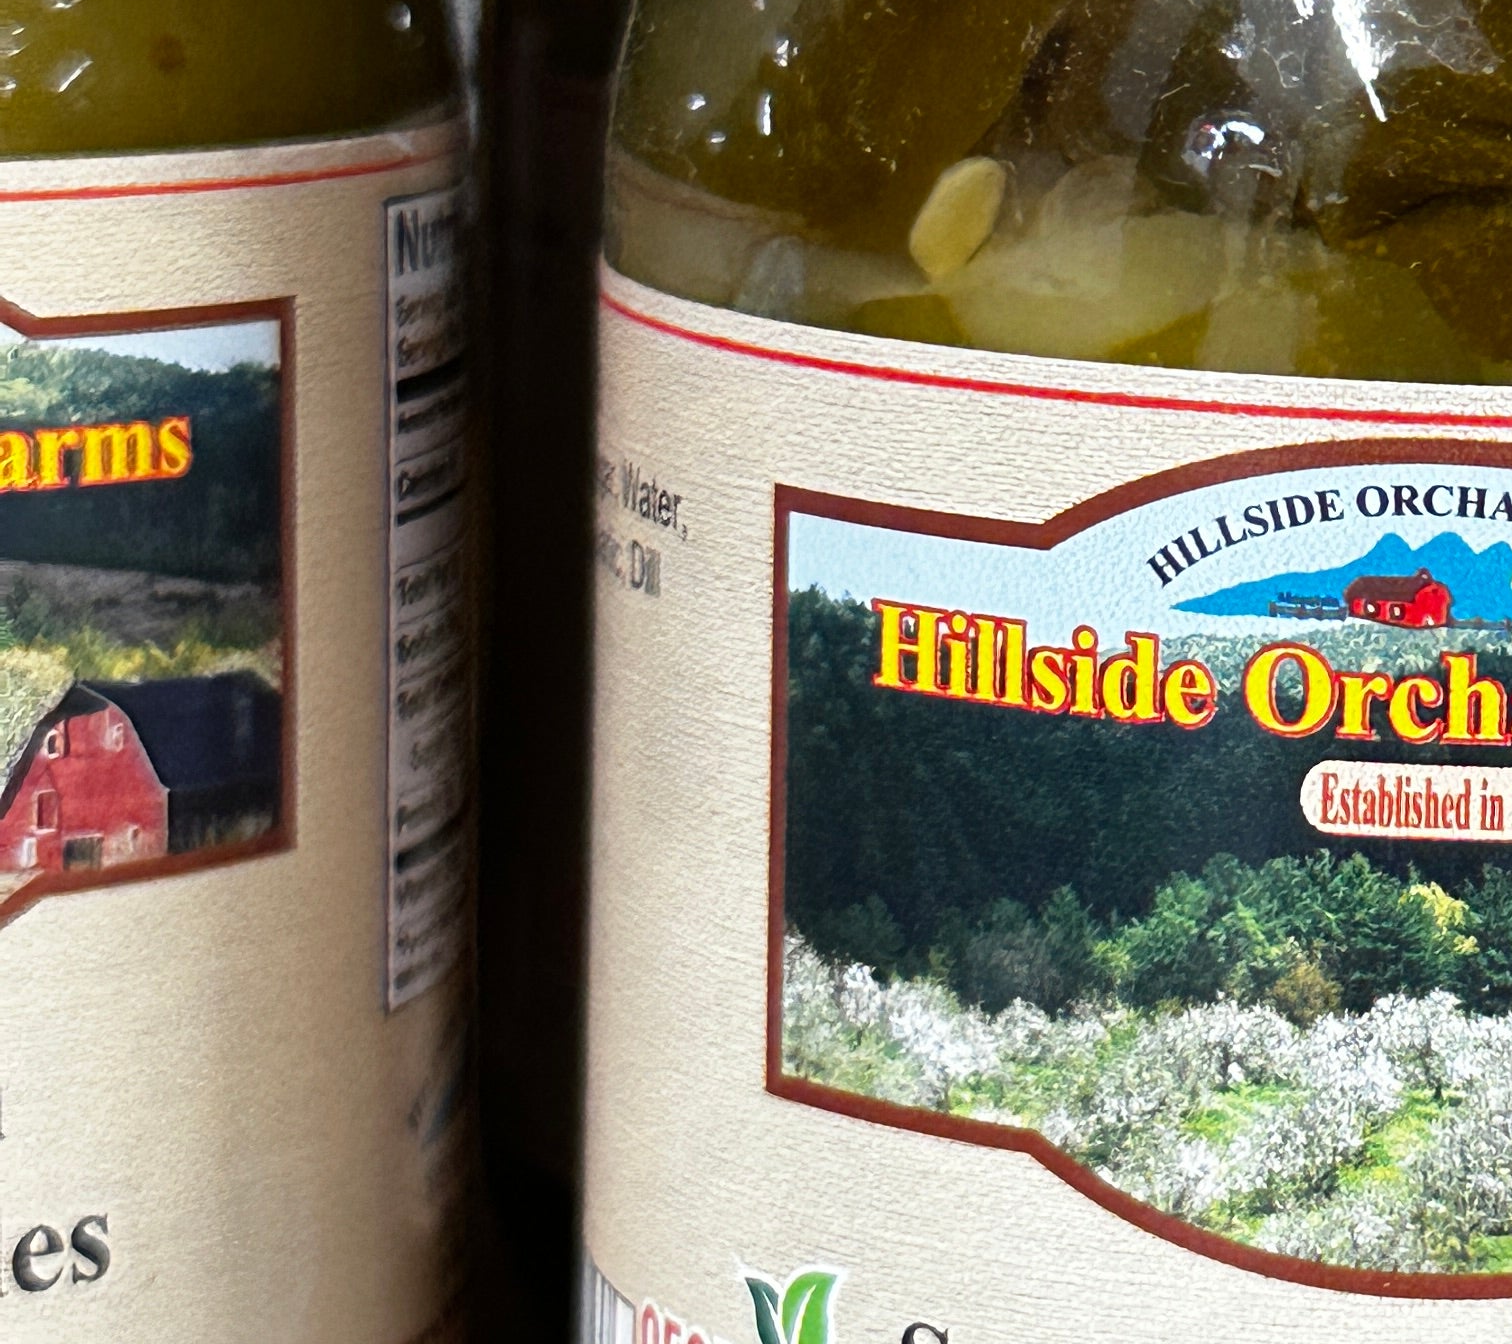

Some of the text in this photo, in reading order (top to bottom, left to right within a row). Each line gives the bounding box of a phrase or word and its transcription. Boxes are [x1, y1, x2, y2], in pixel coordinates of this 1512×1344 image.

[1146, 489, 1344, 588] HILLSIDE
[871, 598, 1218, 730] Hillside
[1319, 772, 1471, 830] Established
[1480, 777, 1504, 831] in
